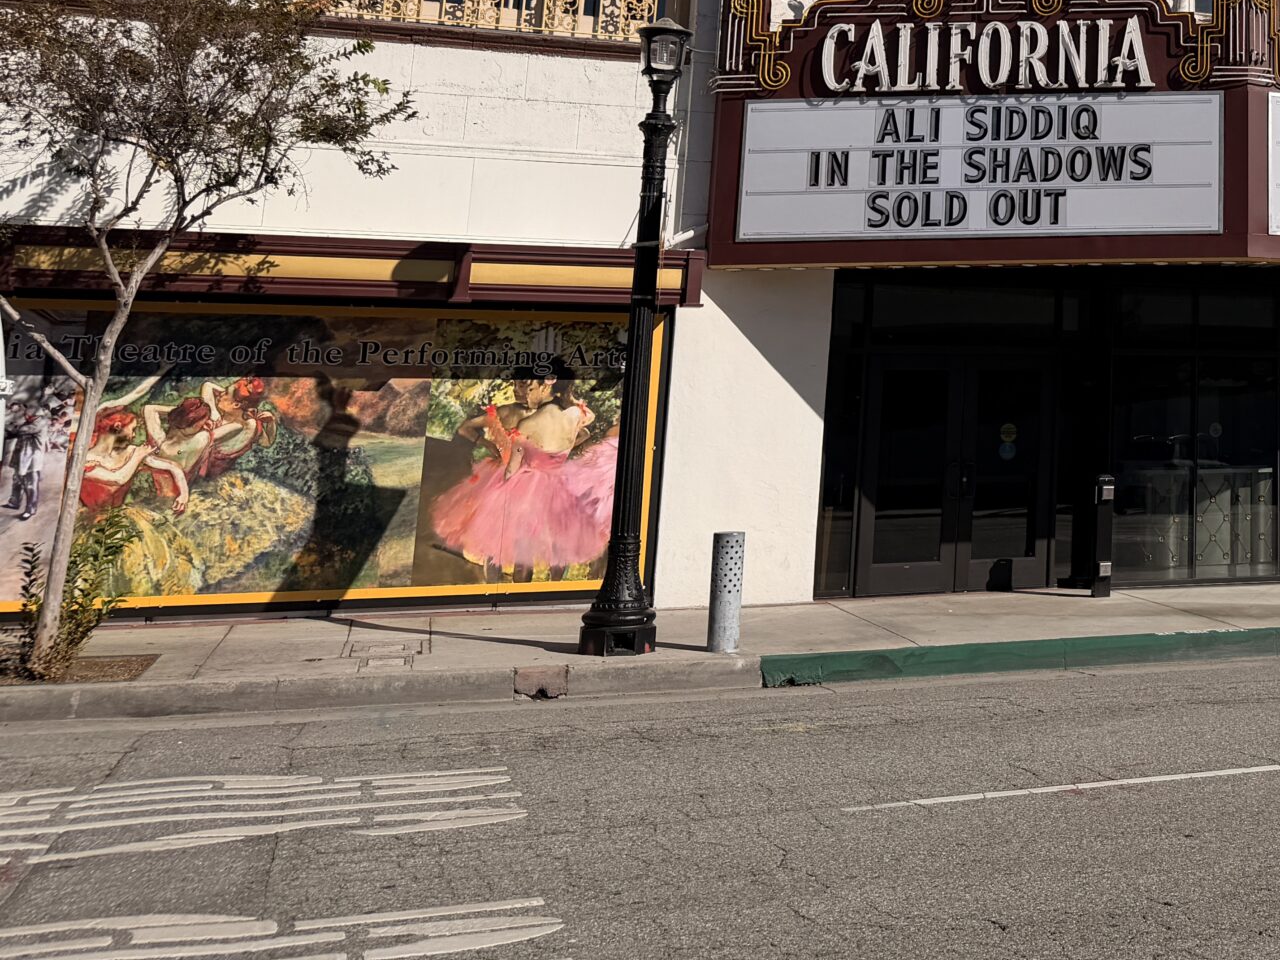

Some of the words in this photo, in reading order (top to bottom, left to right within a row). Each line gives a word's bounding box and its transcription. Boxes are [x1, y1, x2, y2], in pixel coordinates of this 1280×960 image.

[821, 14, 1155, 92] CALIFORNIA
[877, 107, 940, 143] ALI
[965, 104, 1099, 143] SIDDIQ
[809, 151, 849, 187] IN
[871, 149, 940, 185] THE
[963, 144, 1152, 184] SHADOWS
[867, 189, 968, 228] SOLD
[988, 188, 1067, 225] OUT
[229, 337, 273, 365] of
[287, 339, 343, 366] the
[356, 340, 555, 376] Performing
